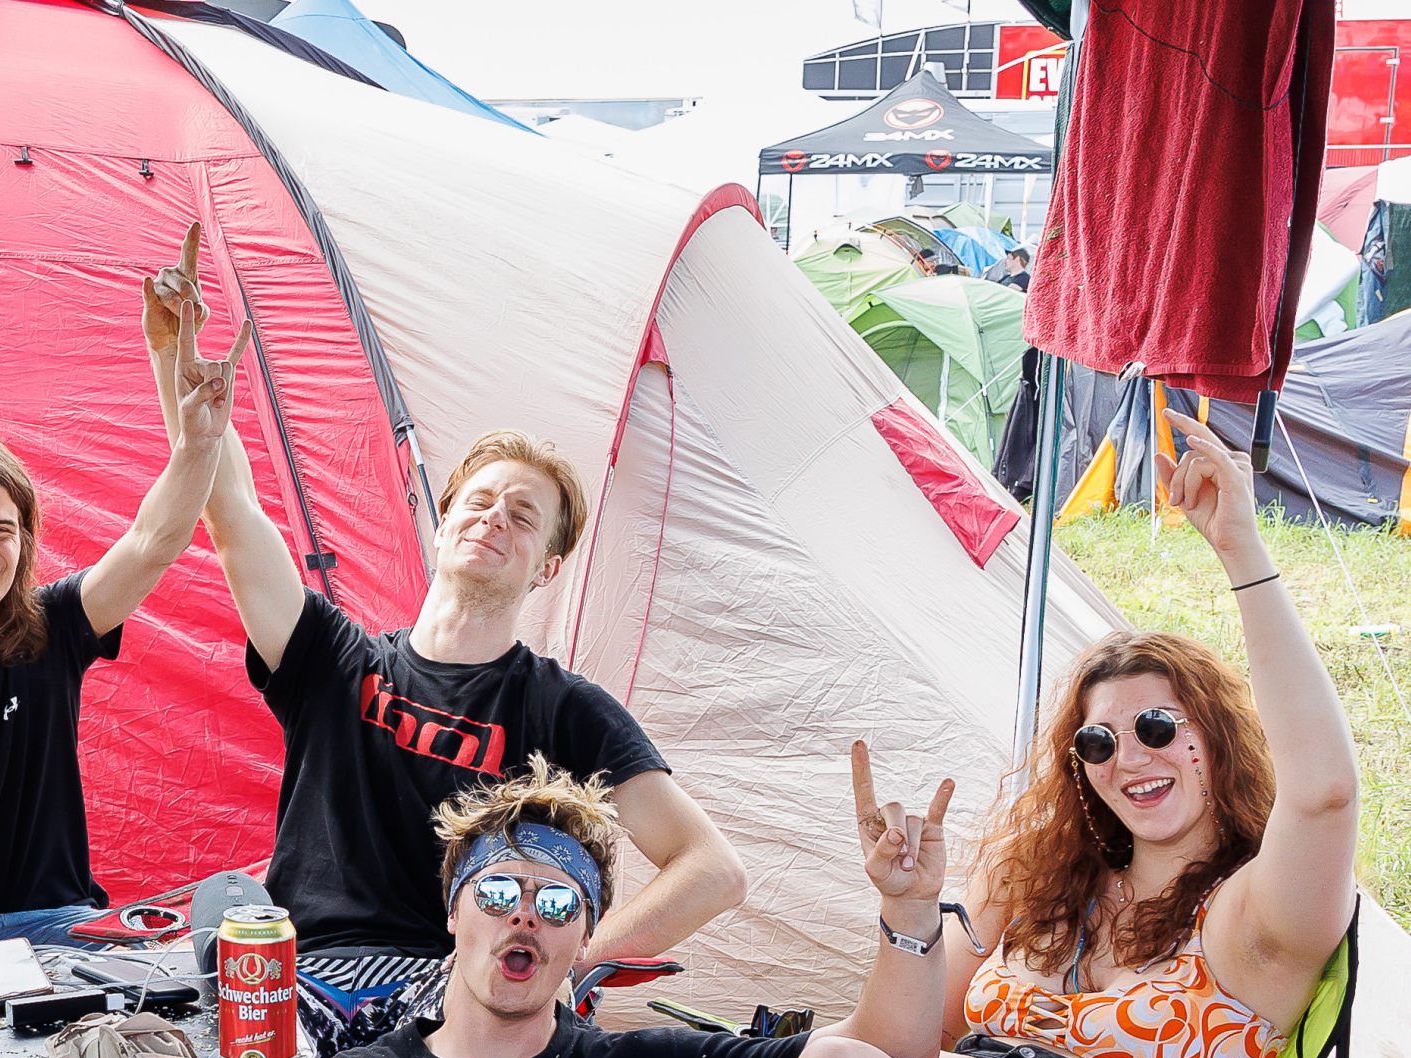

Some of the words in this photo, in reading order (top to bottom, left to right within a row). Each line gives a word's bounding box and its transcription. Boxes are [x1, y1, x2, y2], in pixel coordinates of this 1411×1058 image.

[863, 129, 955, 142] 24MX
[808, 152, 894, 169] 24MX
[954, 153, 1043, 170] 24MX
[217, 981, 294, 1006] Schwechater
[238, 1005, 268, 1021] Bier
